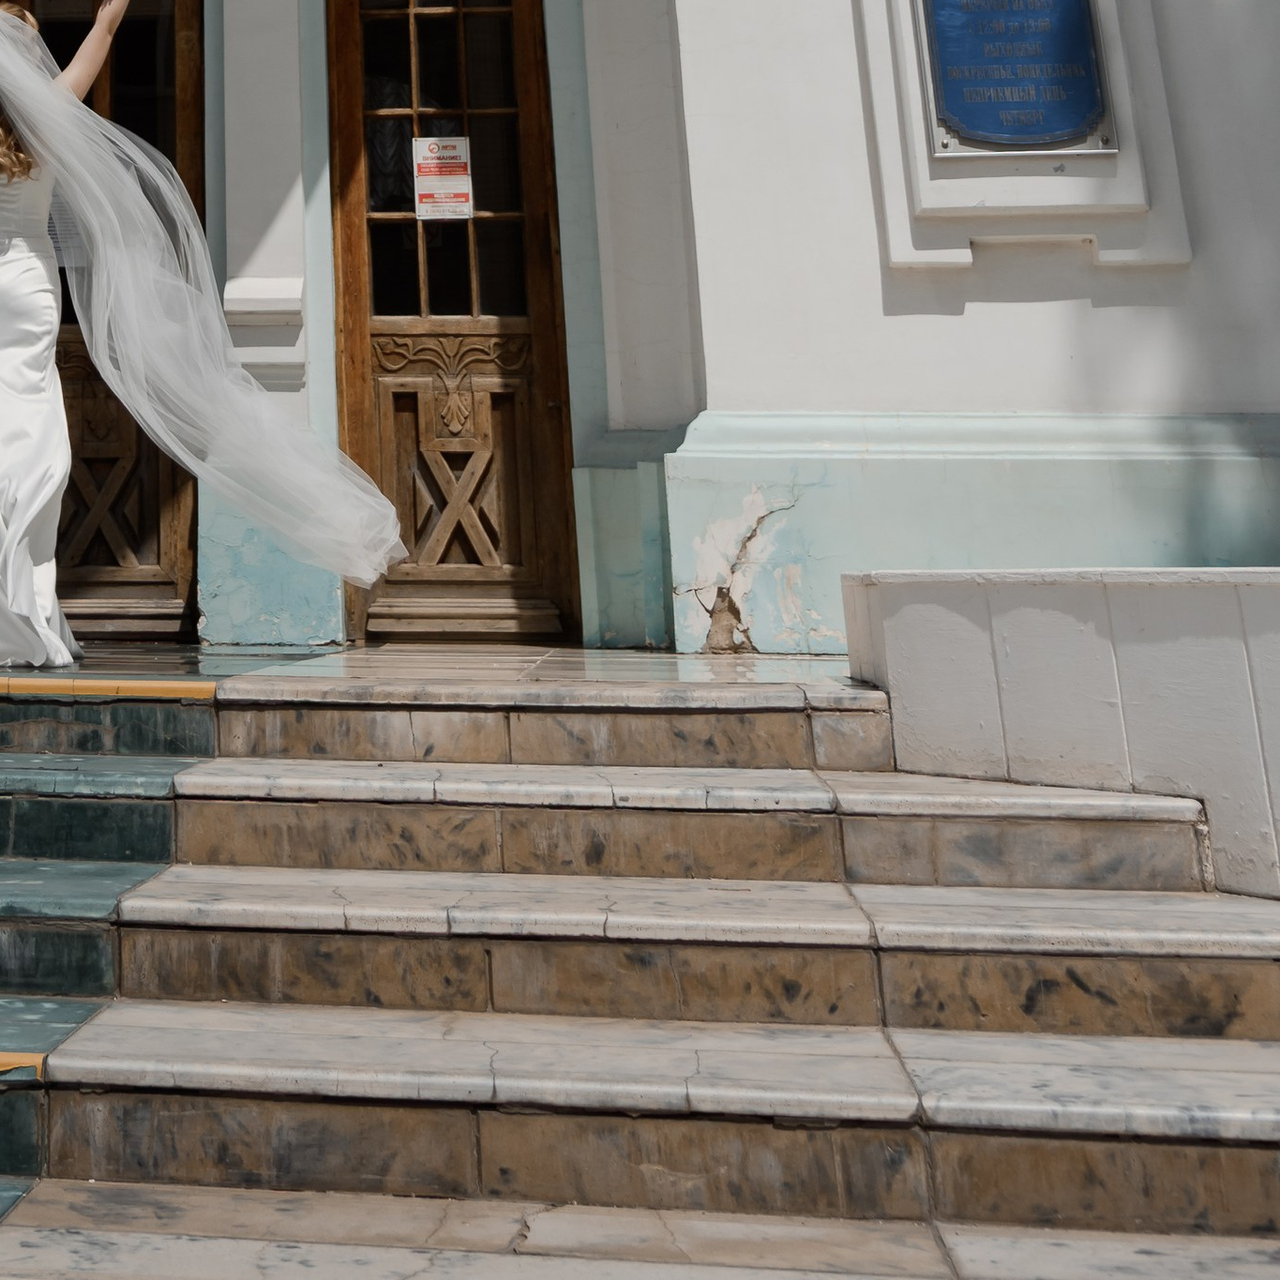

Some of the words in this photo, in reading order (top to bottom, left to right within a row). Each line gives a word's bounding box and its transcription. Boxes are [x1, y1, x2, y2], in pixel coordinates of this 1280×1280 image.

[1007, 21, 1020, 36] до
[962, 84, 1037, 103] НЕПРИЕМНЫЙ
[1039, 85, 1067, 103] ДЕНЬ
[999, 110, 1046, 126] ЧЕТВЕРГ
